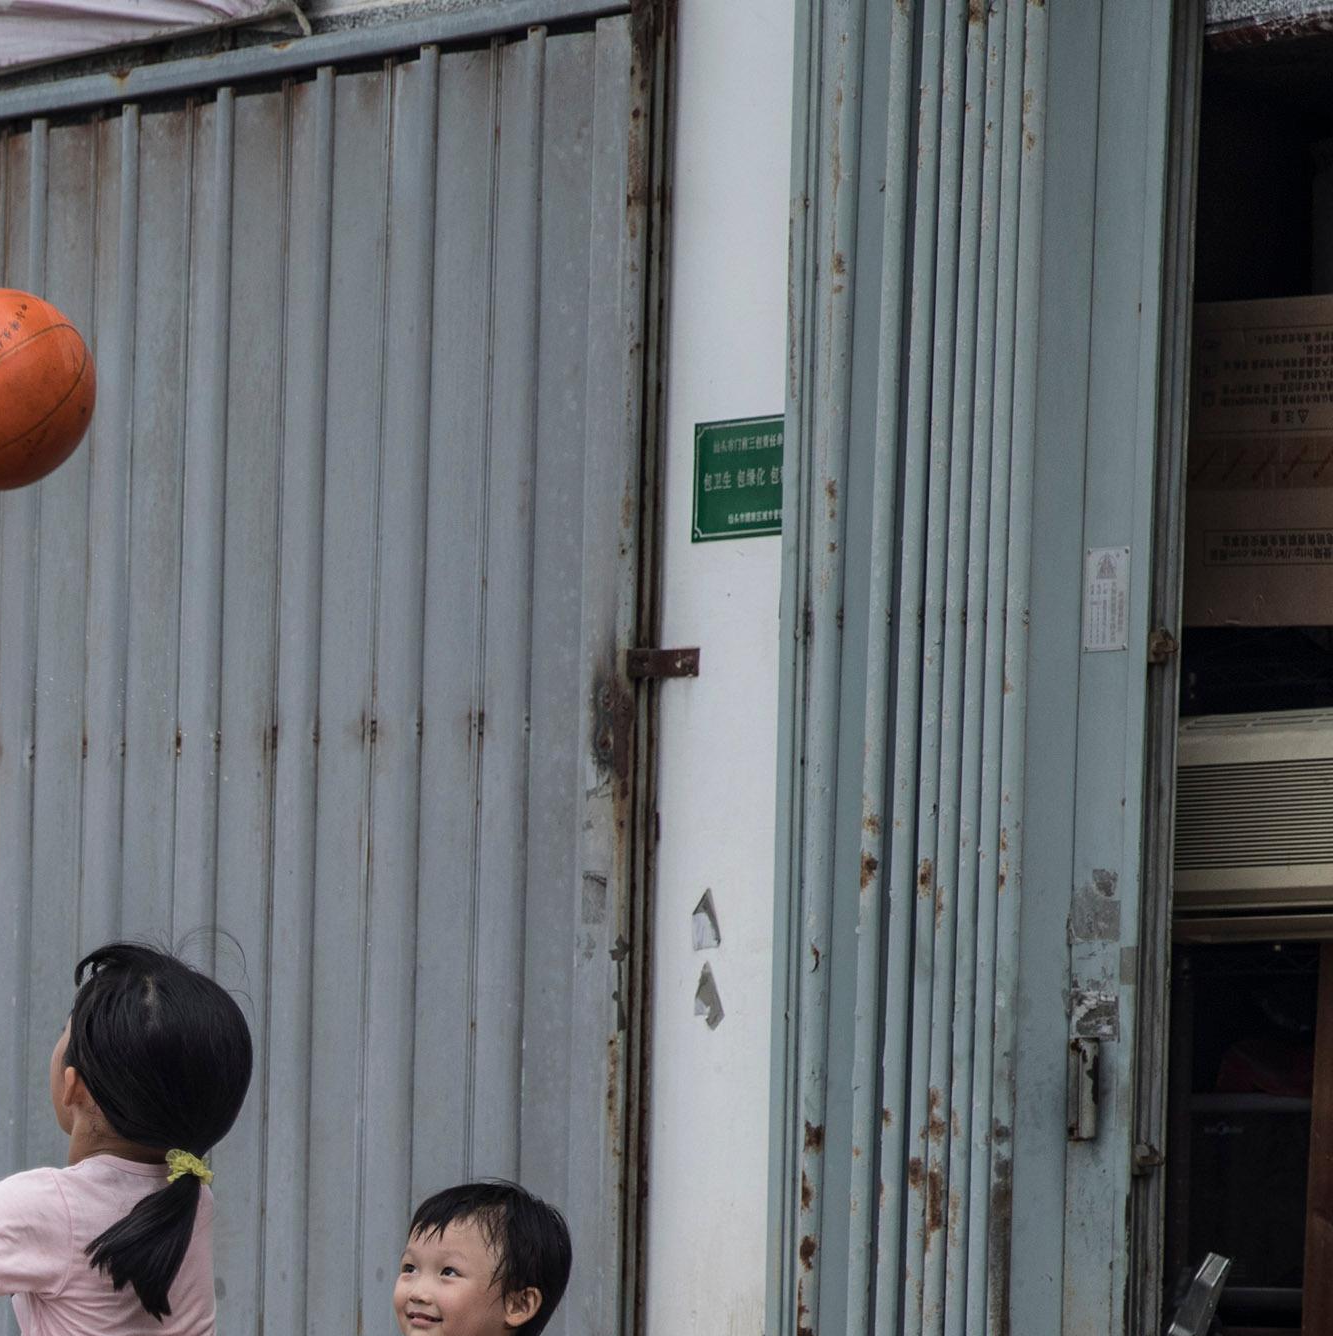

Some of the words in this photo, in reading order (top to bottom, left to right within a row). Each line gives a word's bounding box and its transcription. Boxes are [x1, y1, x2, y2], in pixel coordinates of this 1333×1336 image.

[704, 472, 732, 492] 包卫生
[771, 465, 784, 485] 包
